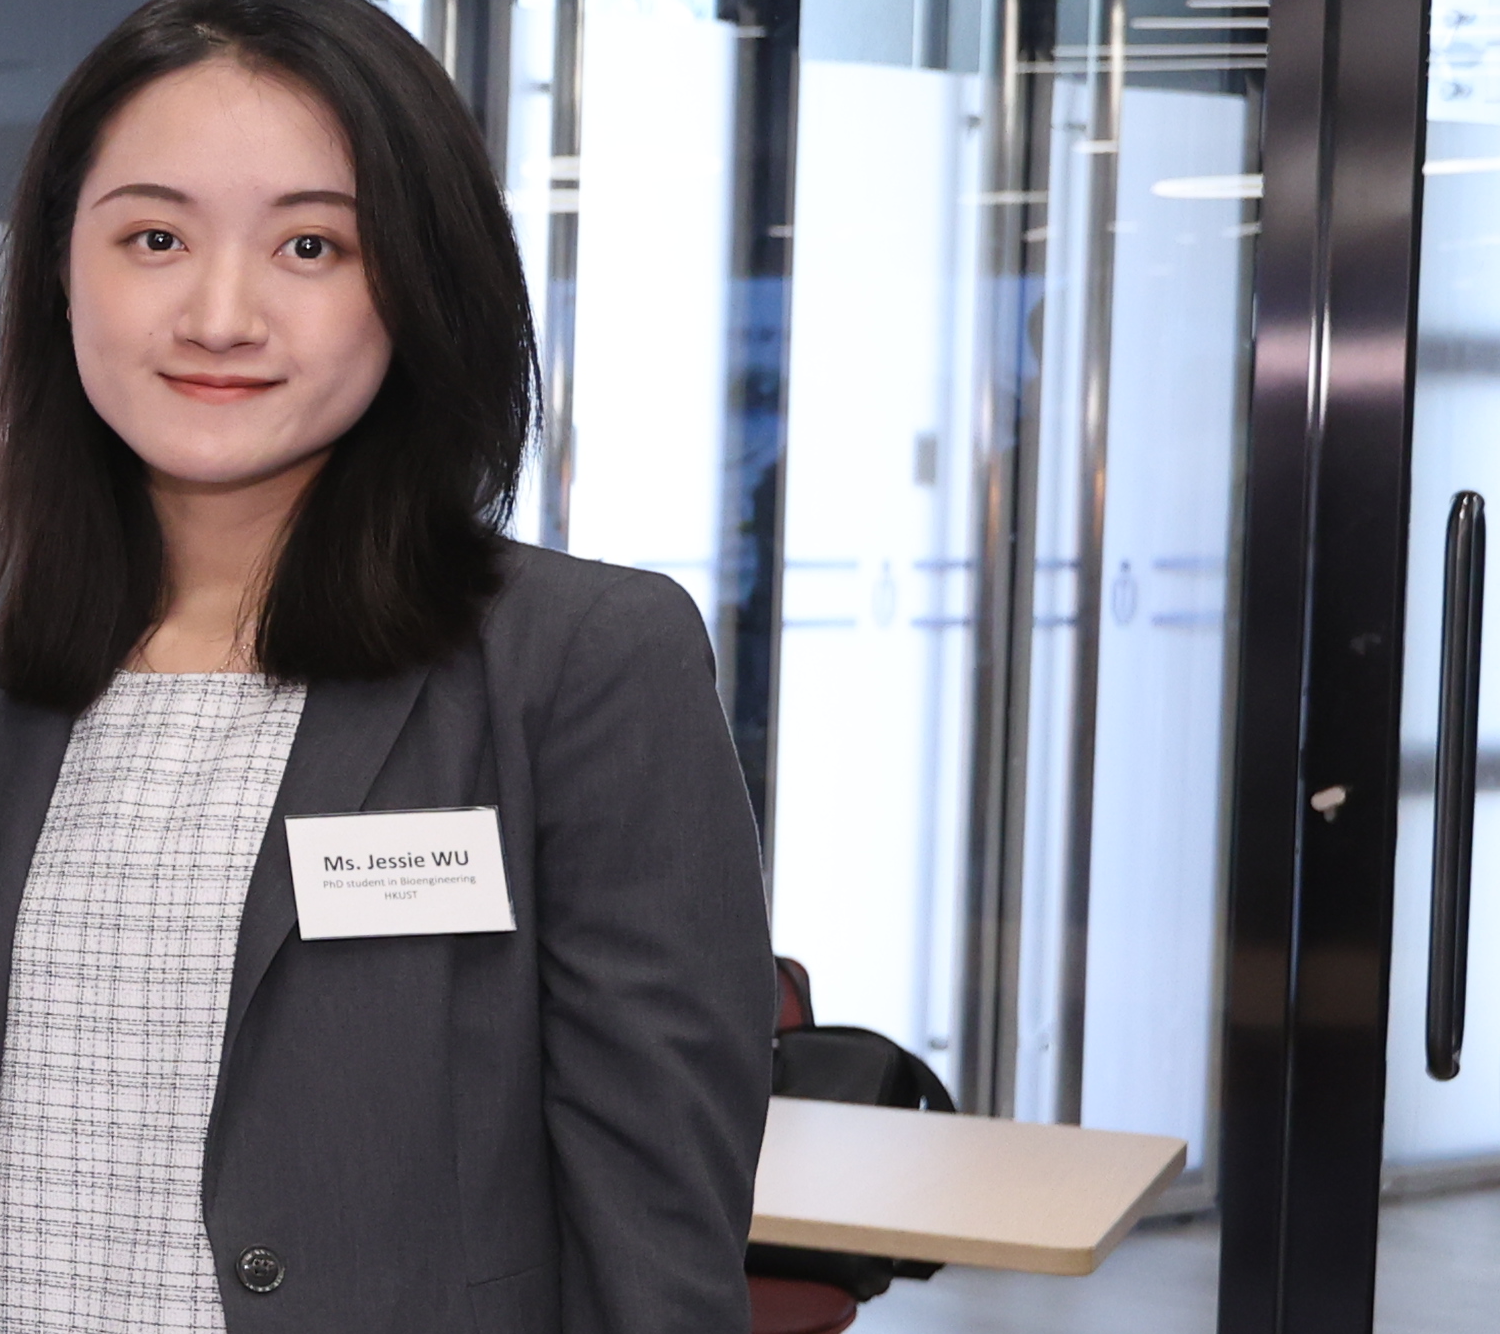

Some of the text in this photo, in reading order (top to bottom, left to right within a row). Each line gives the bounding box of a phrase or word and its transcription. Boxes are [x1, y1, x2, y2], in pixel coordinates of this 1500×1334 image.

[323, 850, 469, 872] Ms. Jessie WU
[323, 874, 476, 889] PhD student in Bioengineering
[384, 890, 418, 900] HKUST
